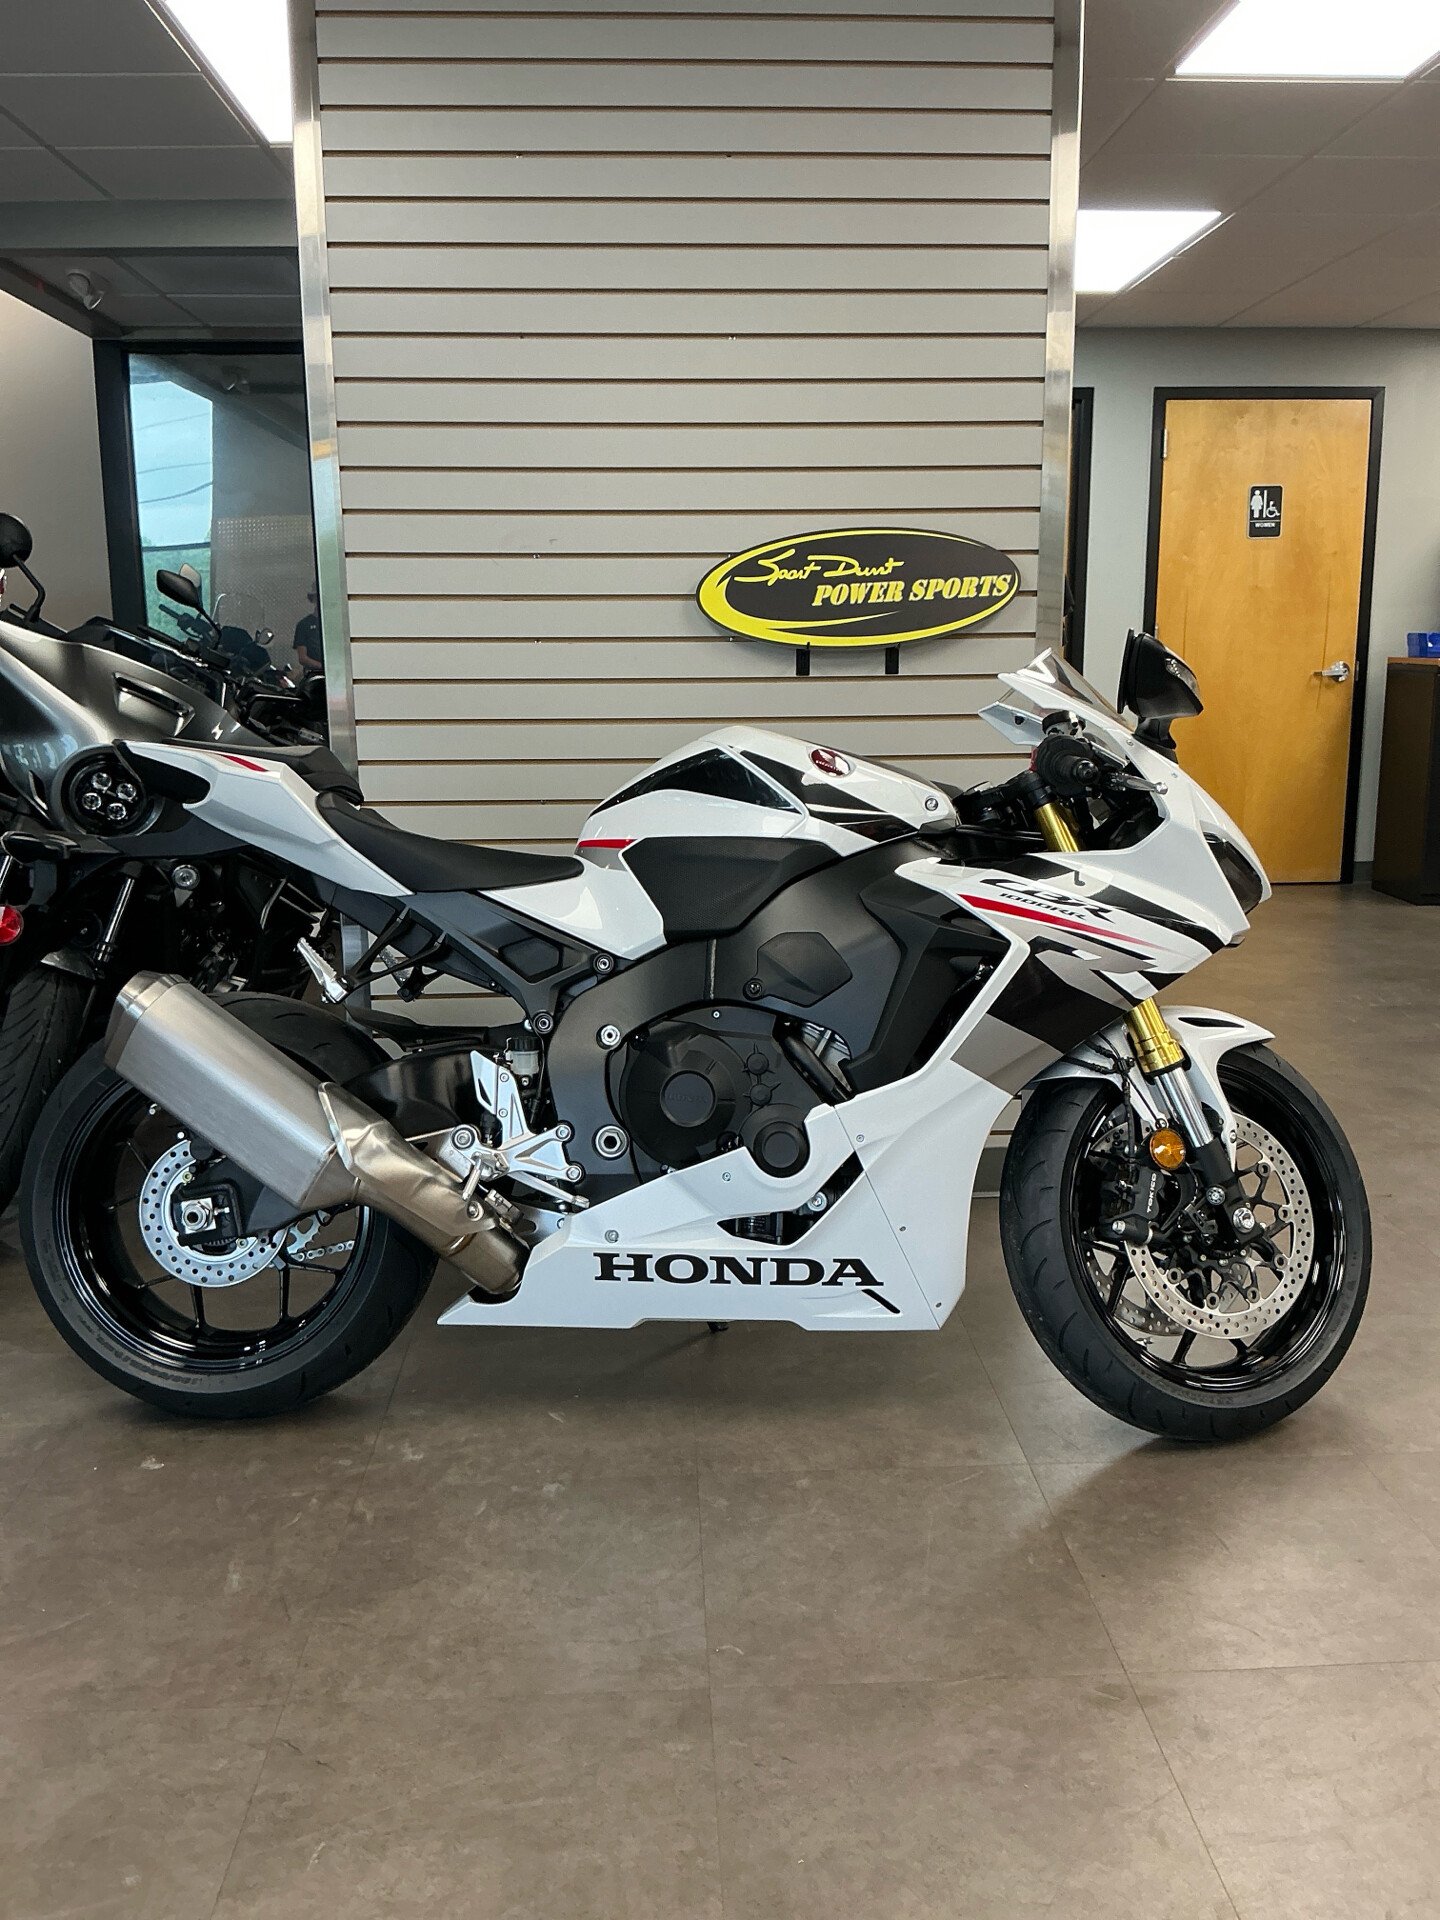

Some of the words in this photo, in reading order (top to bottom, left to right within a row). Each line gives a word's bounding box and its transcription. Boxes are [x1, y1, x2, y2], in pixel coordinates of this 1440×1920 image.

[811, 580, 905, 607] POWER
[908, 574, 1013, 602] SPORTS
[980, 878, 1116, 924] CBR
[1146, 1172, 1157, 1213] TOKICO
[592, 1252, 884, 1287] HONDA
